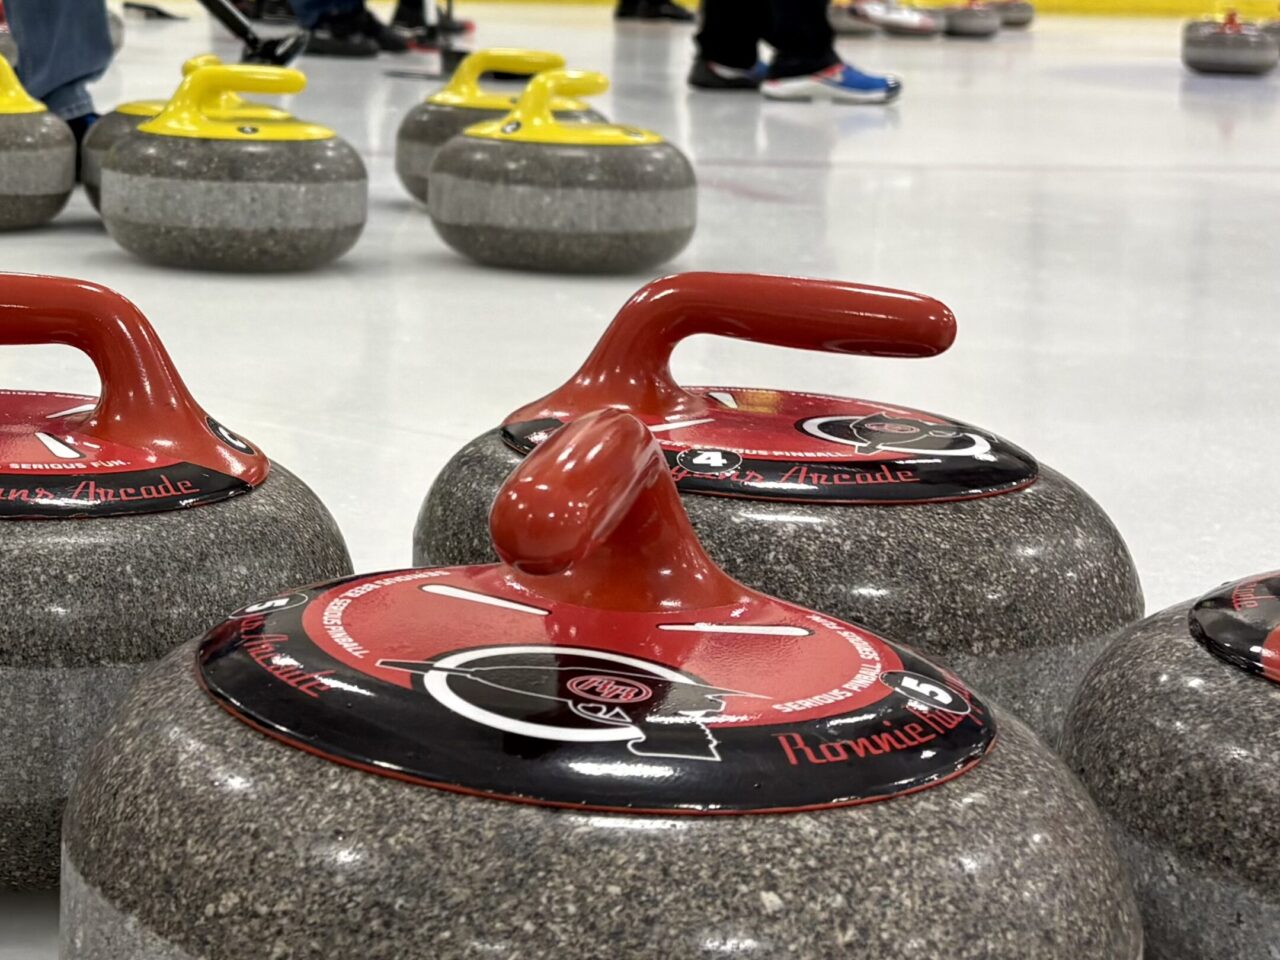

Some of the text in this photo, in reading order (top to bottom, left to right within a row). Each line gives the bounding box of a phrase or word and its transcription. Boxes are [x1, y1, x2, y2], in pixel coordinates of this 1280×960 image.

[8, 461, 88, 471] SERIOUS
[692, 451, 728, 467] 4
[778, 464, 920, 486] Arcade
[69, 474, 201, 502] Arcade
[244, 597, 290, 613] 5
[771, 687, 854, 714] SERIOUS
[900, 675, 953, 705] 5
[770, 719, 937, 766] Ronnie
